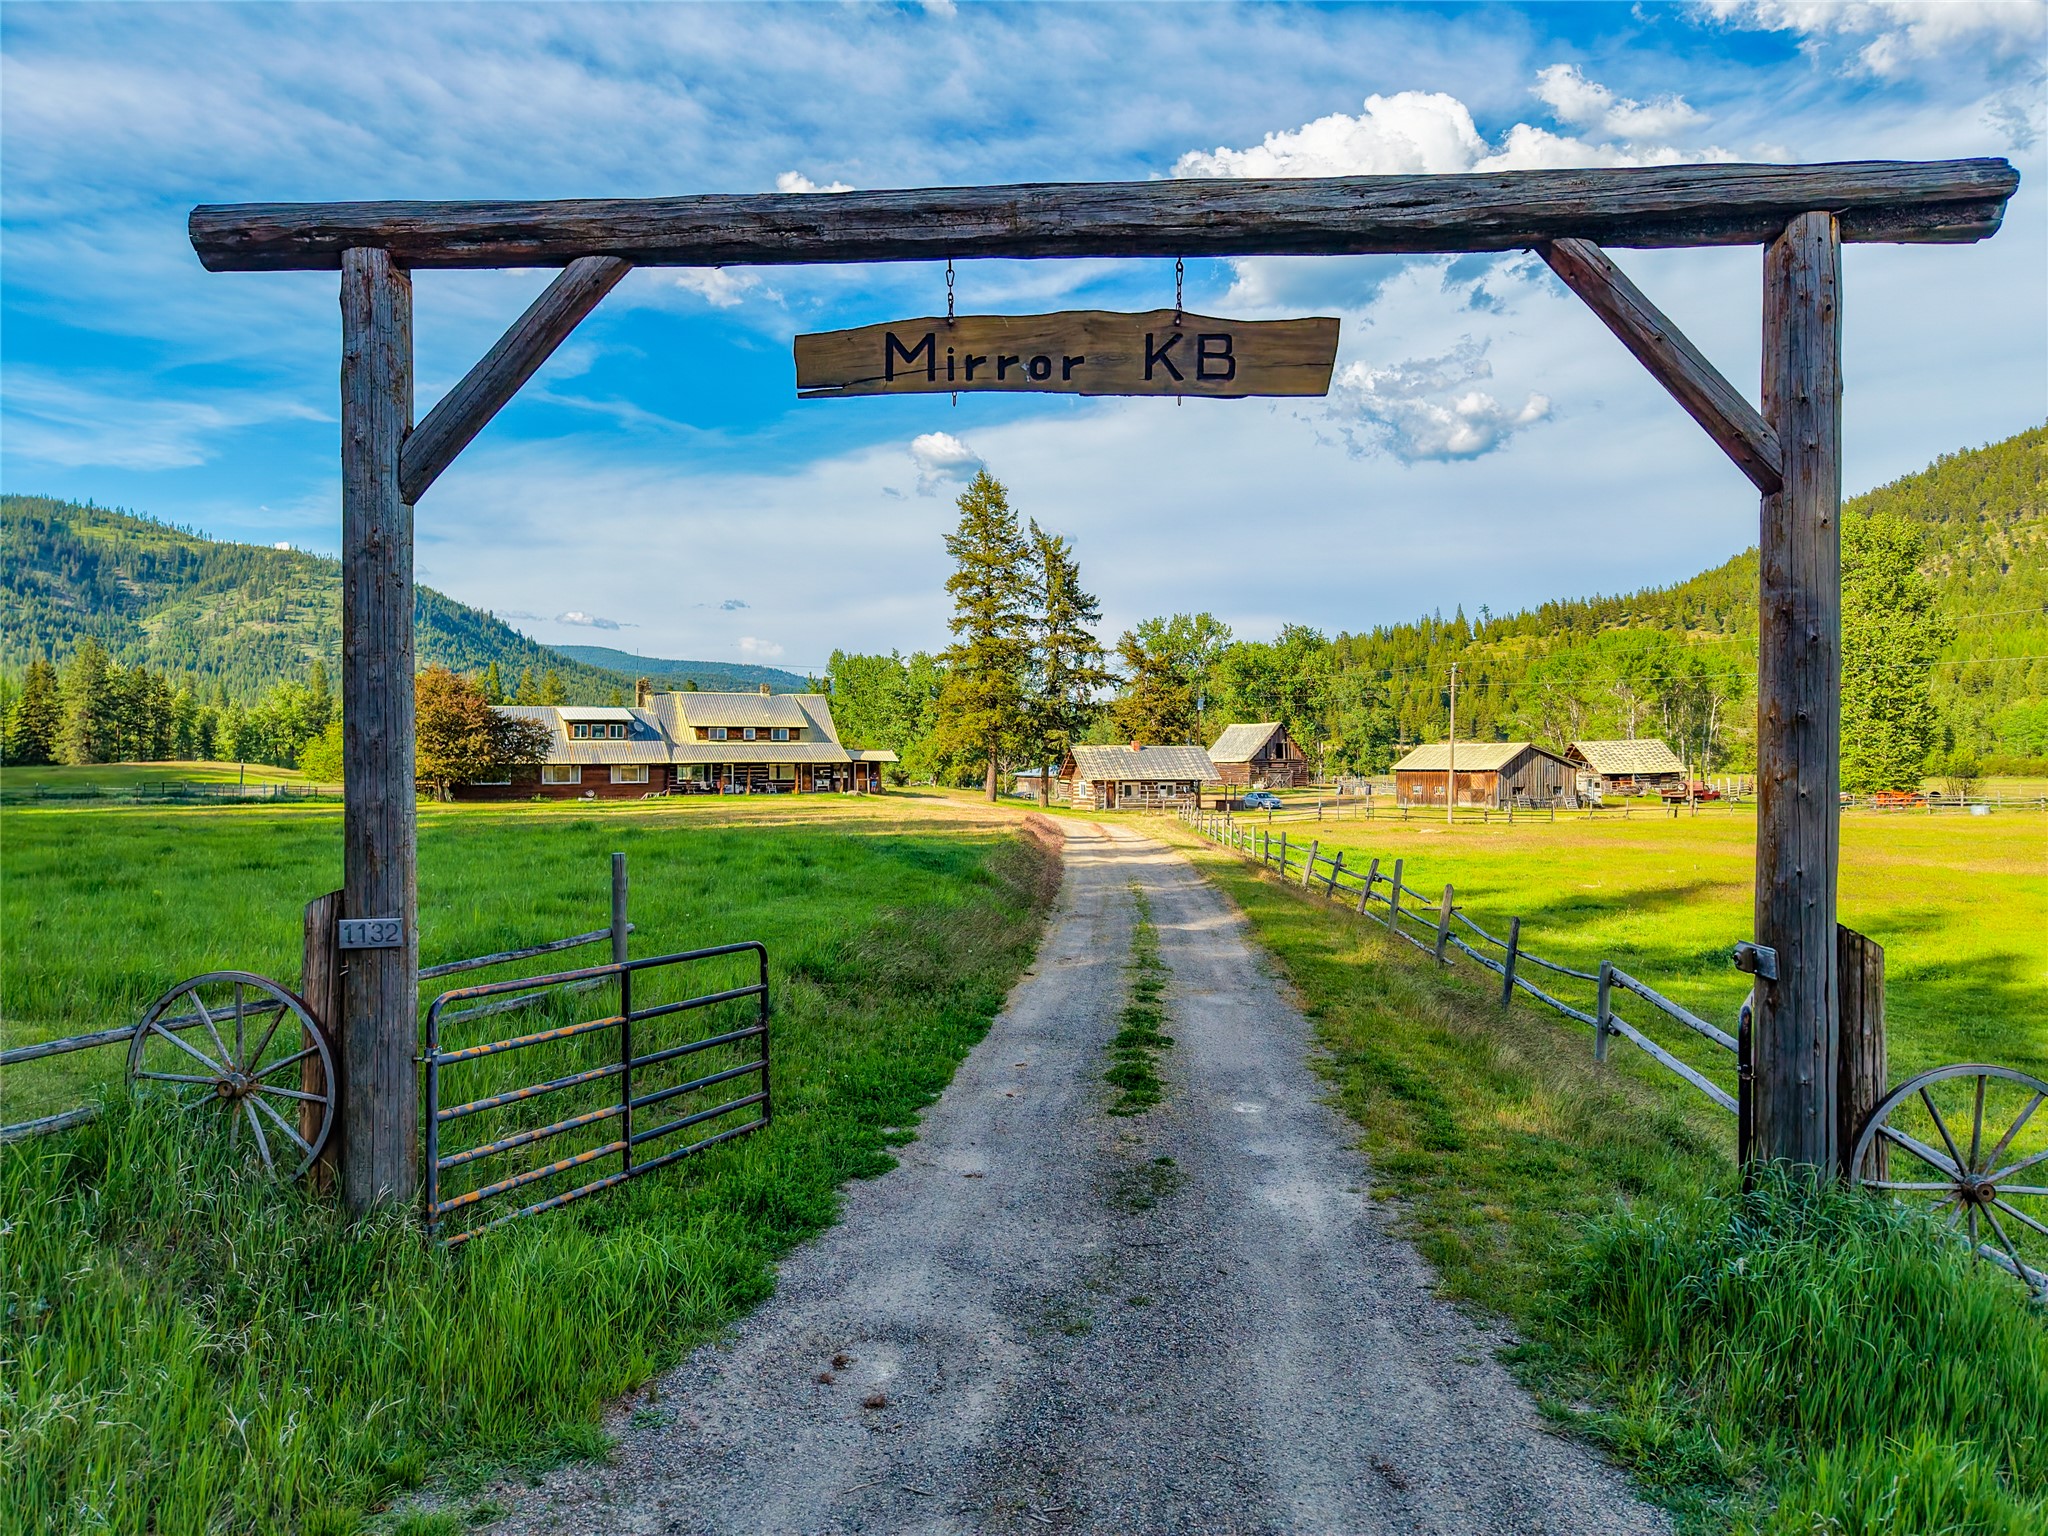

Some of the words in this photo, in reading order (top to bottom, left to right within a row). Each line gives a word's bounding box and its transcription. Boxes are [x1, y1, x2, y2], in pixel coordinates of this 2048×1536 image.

[885, 332, 1085, 383] Mirror
[1144, 332, 1236, 382] KB
[343, 922, 399, 944] 1132
